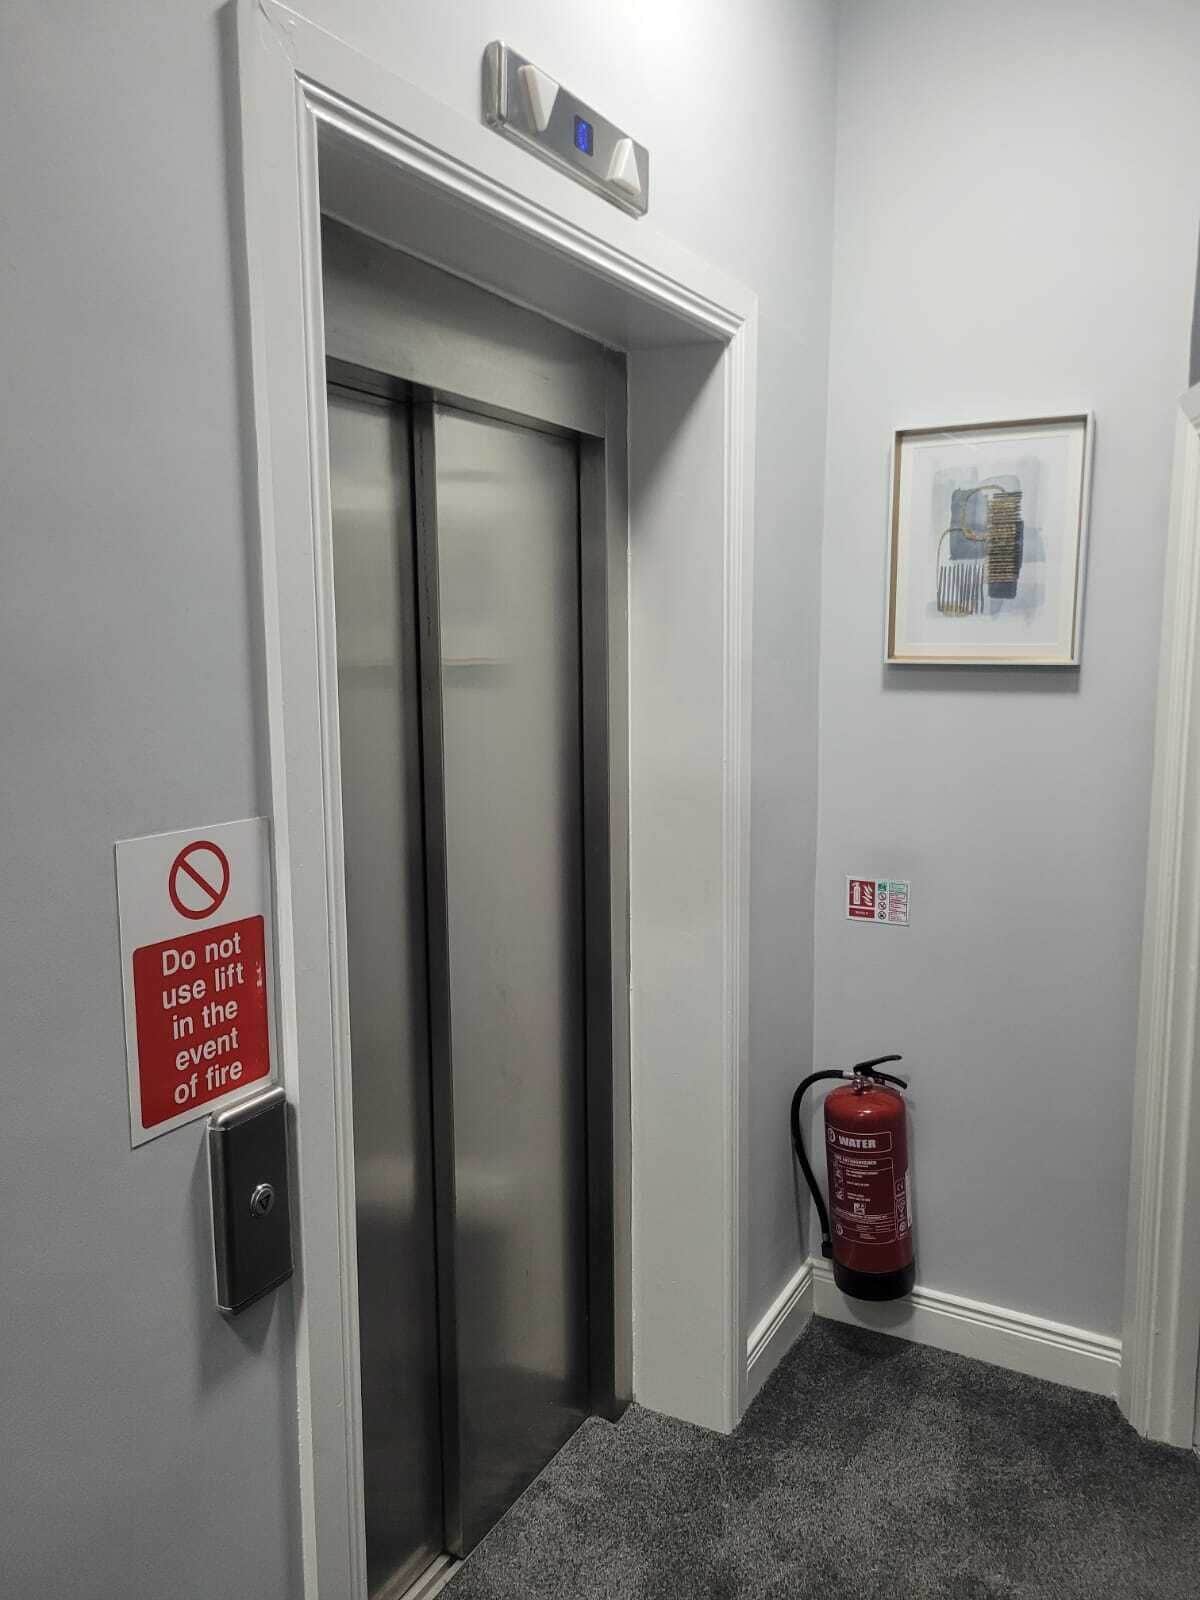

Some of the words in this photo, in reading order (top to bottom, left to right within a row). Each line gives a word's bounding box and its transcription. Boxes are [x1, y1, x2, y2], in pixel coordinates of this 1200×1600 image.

[162, 949, 196, 977] Do
[205, 931, 242, 962] not
[162, 979, 206, 1009] use
[215, 962, 244, 991] lift
[172, 1014, 194, 1040] in
[201, 999, 239, 1029] the
[175, 1027, 239, 1071] event
[173, 1073, 198, 1104] of
[205, 1059, 243, 1091] fire
[838, 1135, 876, 1149] WATER
